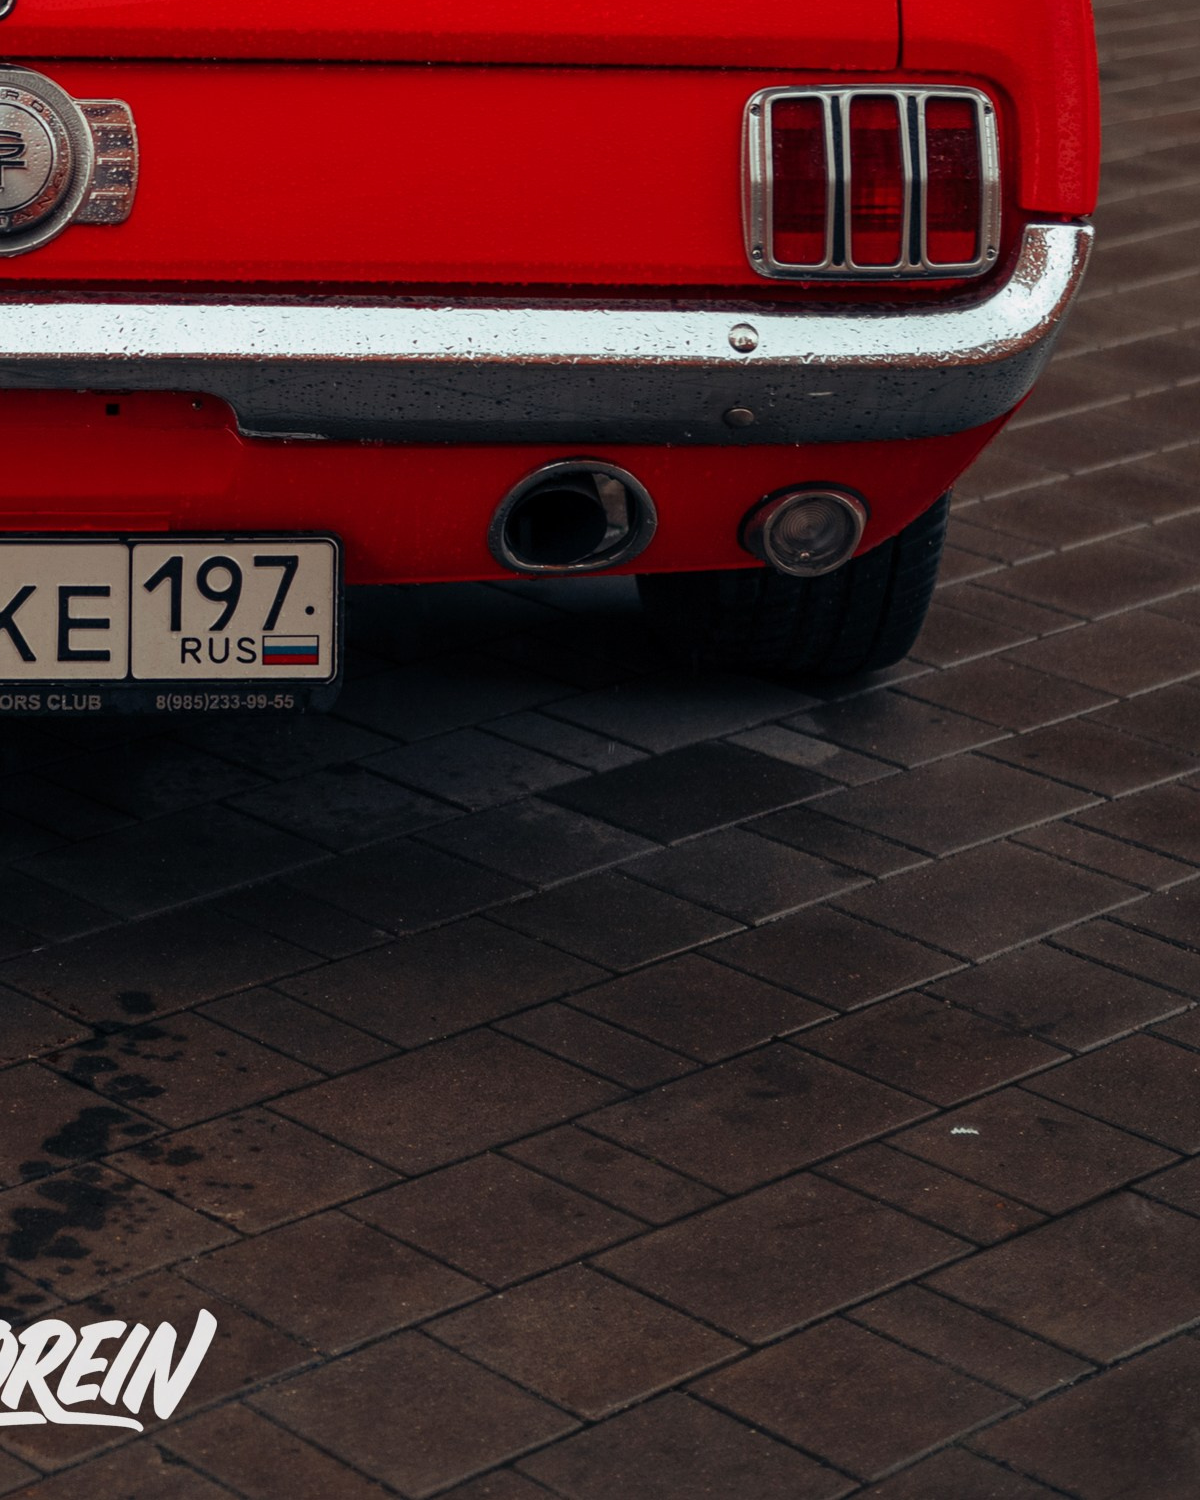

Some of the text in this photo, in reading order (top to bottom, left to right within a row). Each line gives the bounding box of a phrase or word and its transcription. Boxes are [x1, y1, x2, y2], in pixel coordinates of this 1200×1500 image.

[142, 555, 299, 632] 197
[181, 637, 257, 665] RUS
[46, 694, 102, 710] CLUB
[155, 694, 294, 711] 8(985)233-99-55
